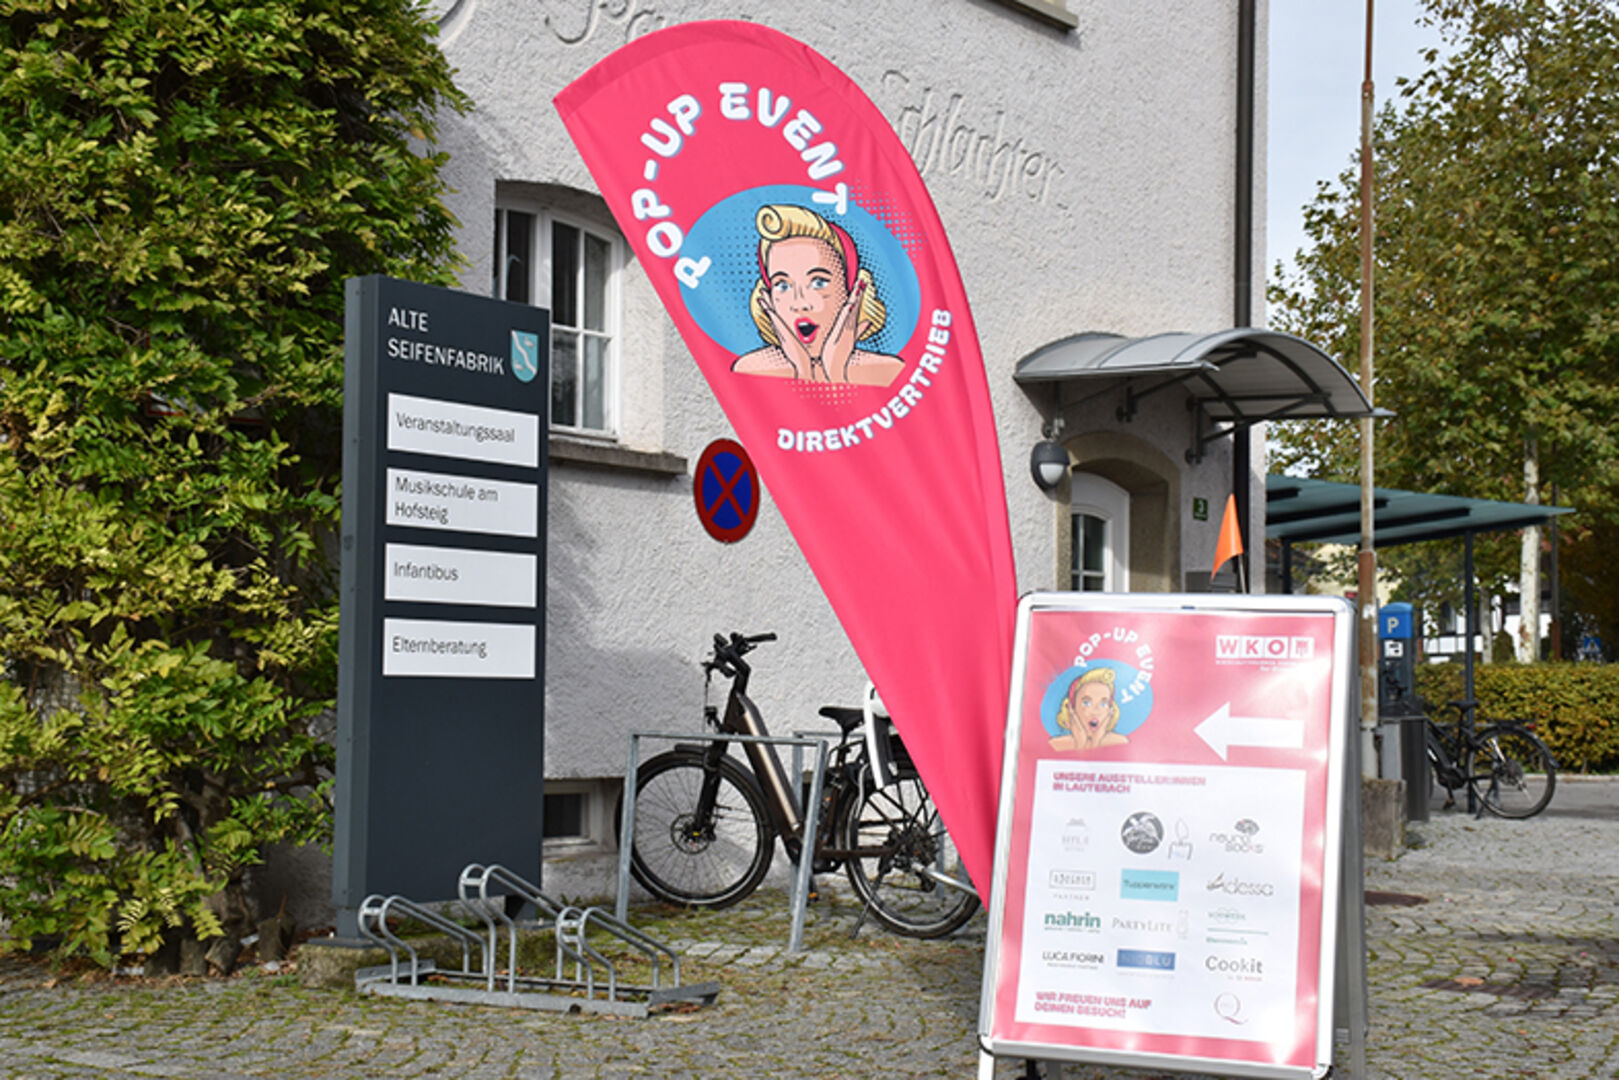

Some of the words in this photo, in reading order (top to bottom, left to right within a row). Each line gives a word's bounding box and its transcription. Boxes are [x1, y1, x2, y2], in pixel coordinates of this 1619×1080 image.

[631, 94, 711, 288] POP-UP
[719, 82, 848, 215] EVENT
[388, 307, 429, 332] ALTE
[387, 337, 505, 375] SEIFENFABRIK
[777, 308, 951, 452] DIREKTVERTRIEB
[396, 412, 515, 443] Veranstaltungssaal
[395, 477, 476, 500] Musikschule
[477, 488, 499, 502] am
[394, 502, 449, 525] Hofsteig
[393, 562, 459, 581] Infantibus
[1388, 617, 1399, 634] P
[392, 636, 488, 659] Elternberatung
[1074, 627, 1138, 667] POP-UP
[1121, 644, 1154, 703] EVENT
[1053, 772, 1096, 782] UNSERE
[1053, 783, 1064, 791] IN
[1066, 784, 1131, 794] LAUTERACH
[1044, 911, 1101, 928] nahrin
[1205, 955, 1263, 974] Cookit
[1035, 1001, 1074, 1013] DEINEN
[1036, 992, 1056, 1001] WIR
[1058, 992, 1101, 1004] FREUEN
[1104, 996, 1126, 1007] UNS
